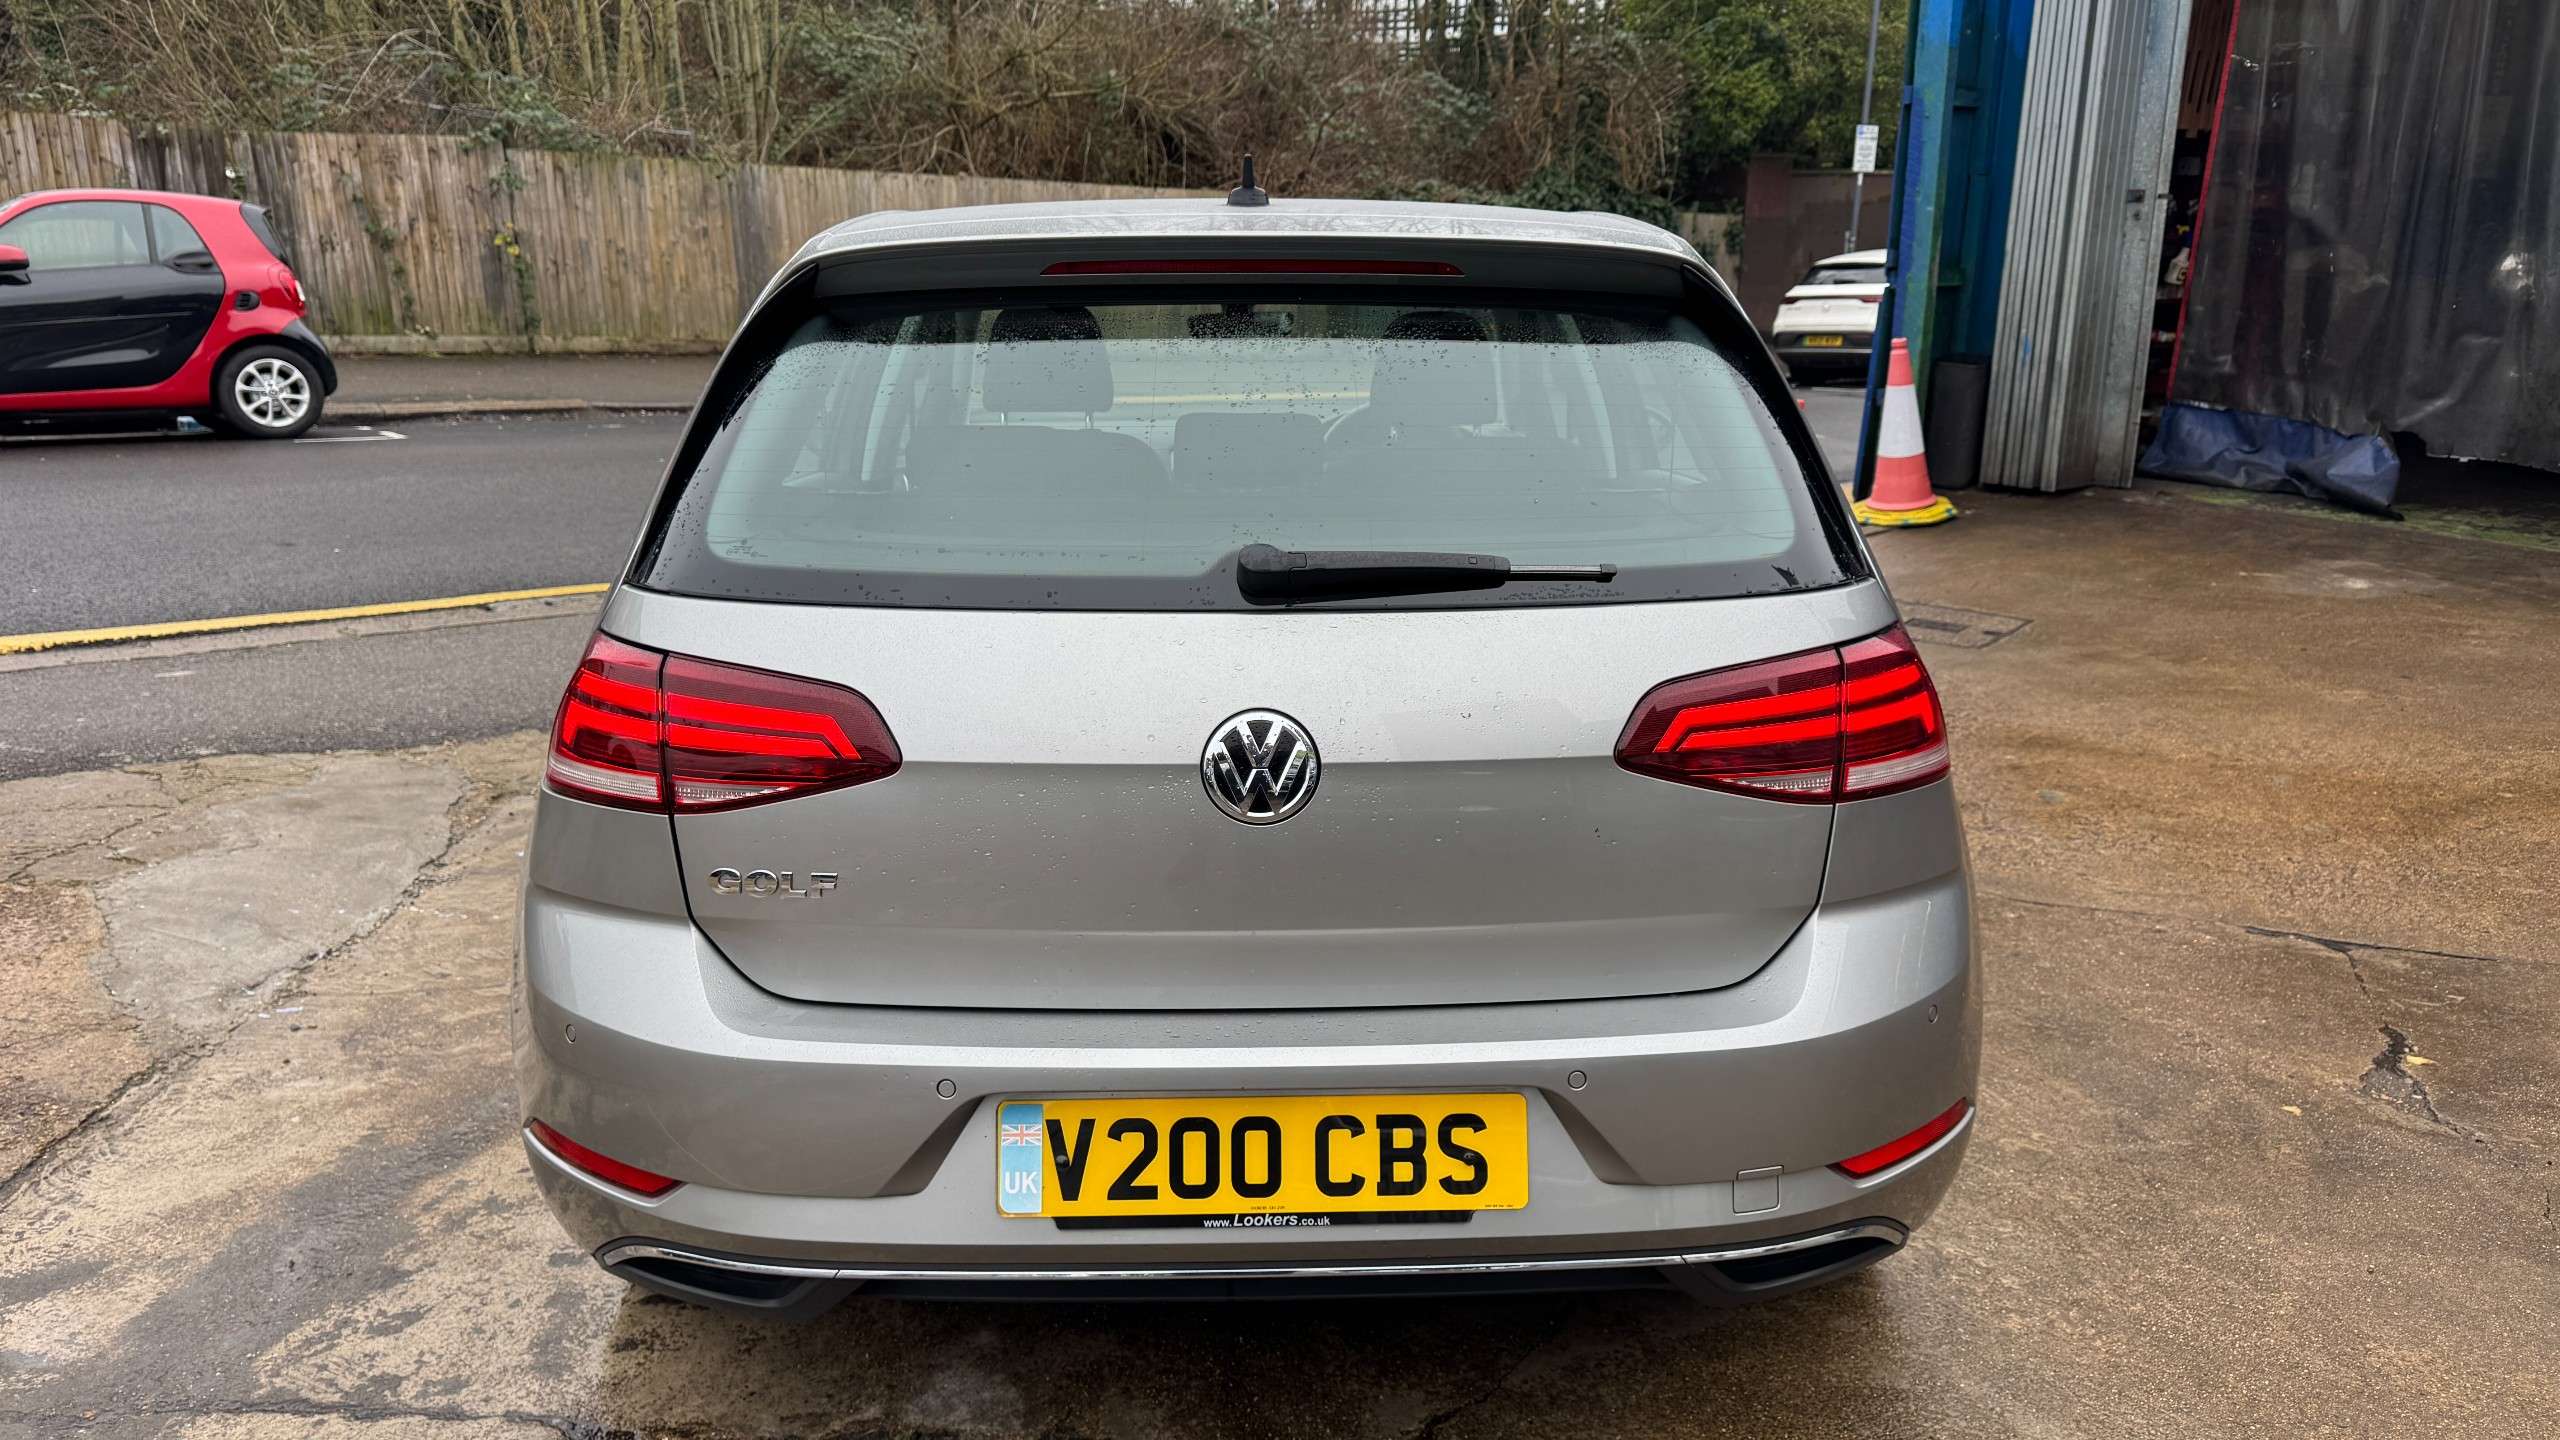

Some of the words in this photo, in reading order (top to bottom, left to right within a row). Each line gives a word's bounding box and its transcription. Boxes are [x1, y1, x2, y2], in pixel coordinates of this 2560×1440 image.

[708, 867, 838, 898] GOLF
[1044, 1115, 1283, 1202] V200
[1314, 1112, 1490, 1198] CBS
[1004, 1171, 1038, 1194] UK
[1203, 1213, 1331, 1228] www.Lookers.co.uk
